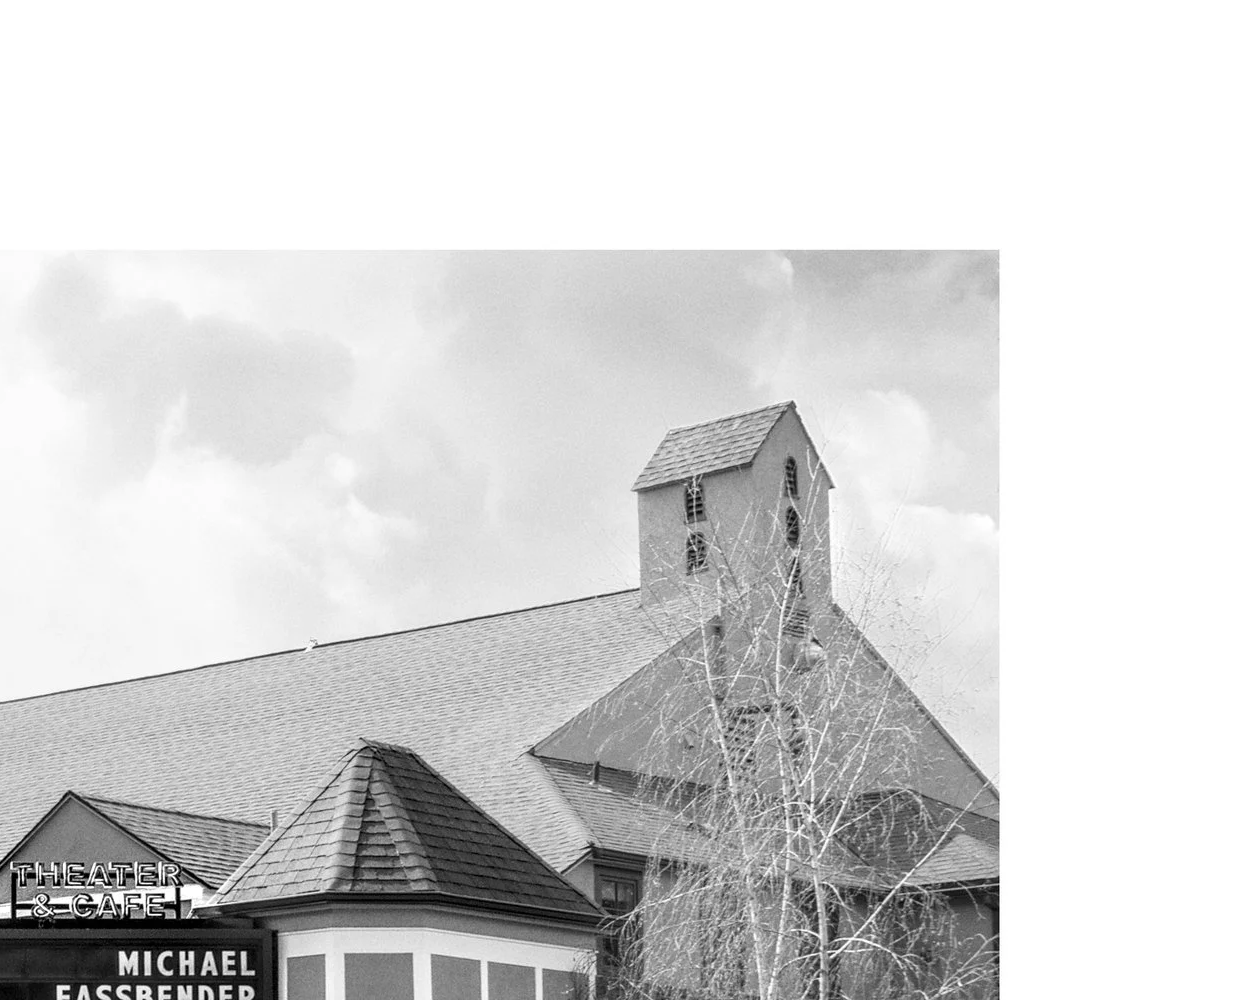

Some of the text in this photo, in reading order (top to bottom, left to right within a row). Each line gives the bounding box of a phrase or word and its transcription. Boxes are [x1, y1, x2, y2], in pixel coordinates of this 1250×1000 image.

[9, 861, 184, 888] THEATER
[31, 892, 168, 919] & CAFE
[118, 950, 256, 977] MICHAEL
